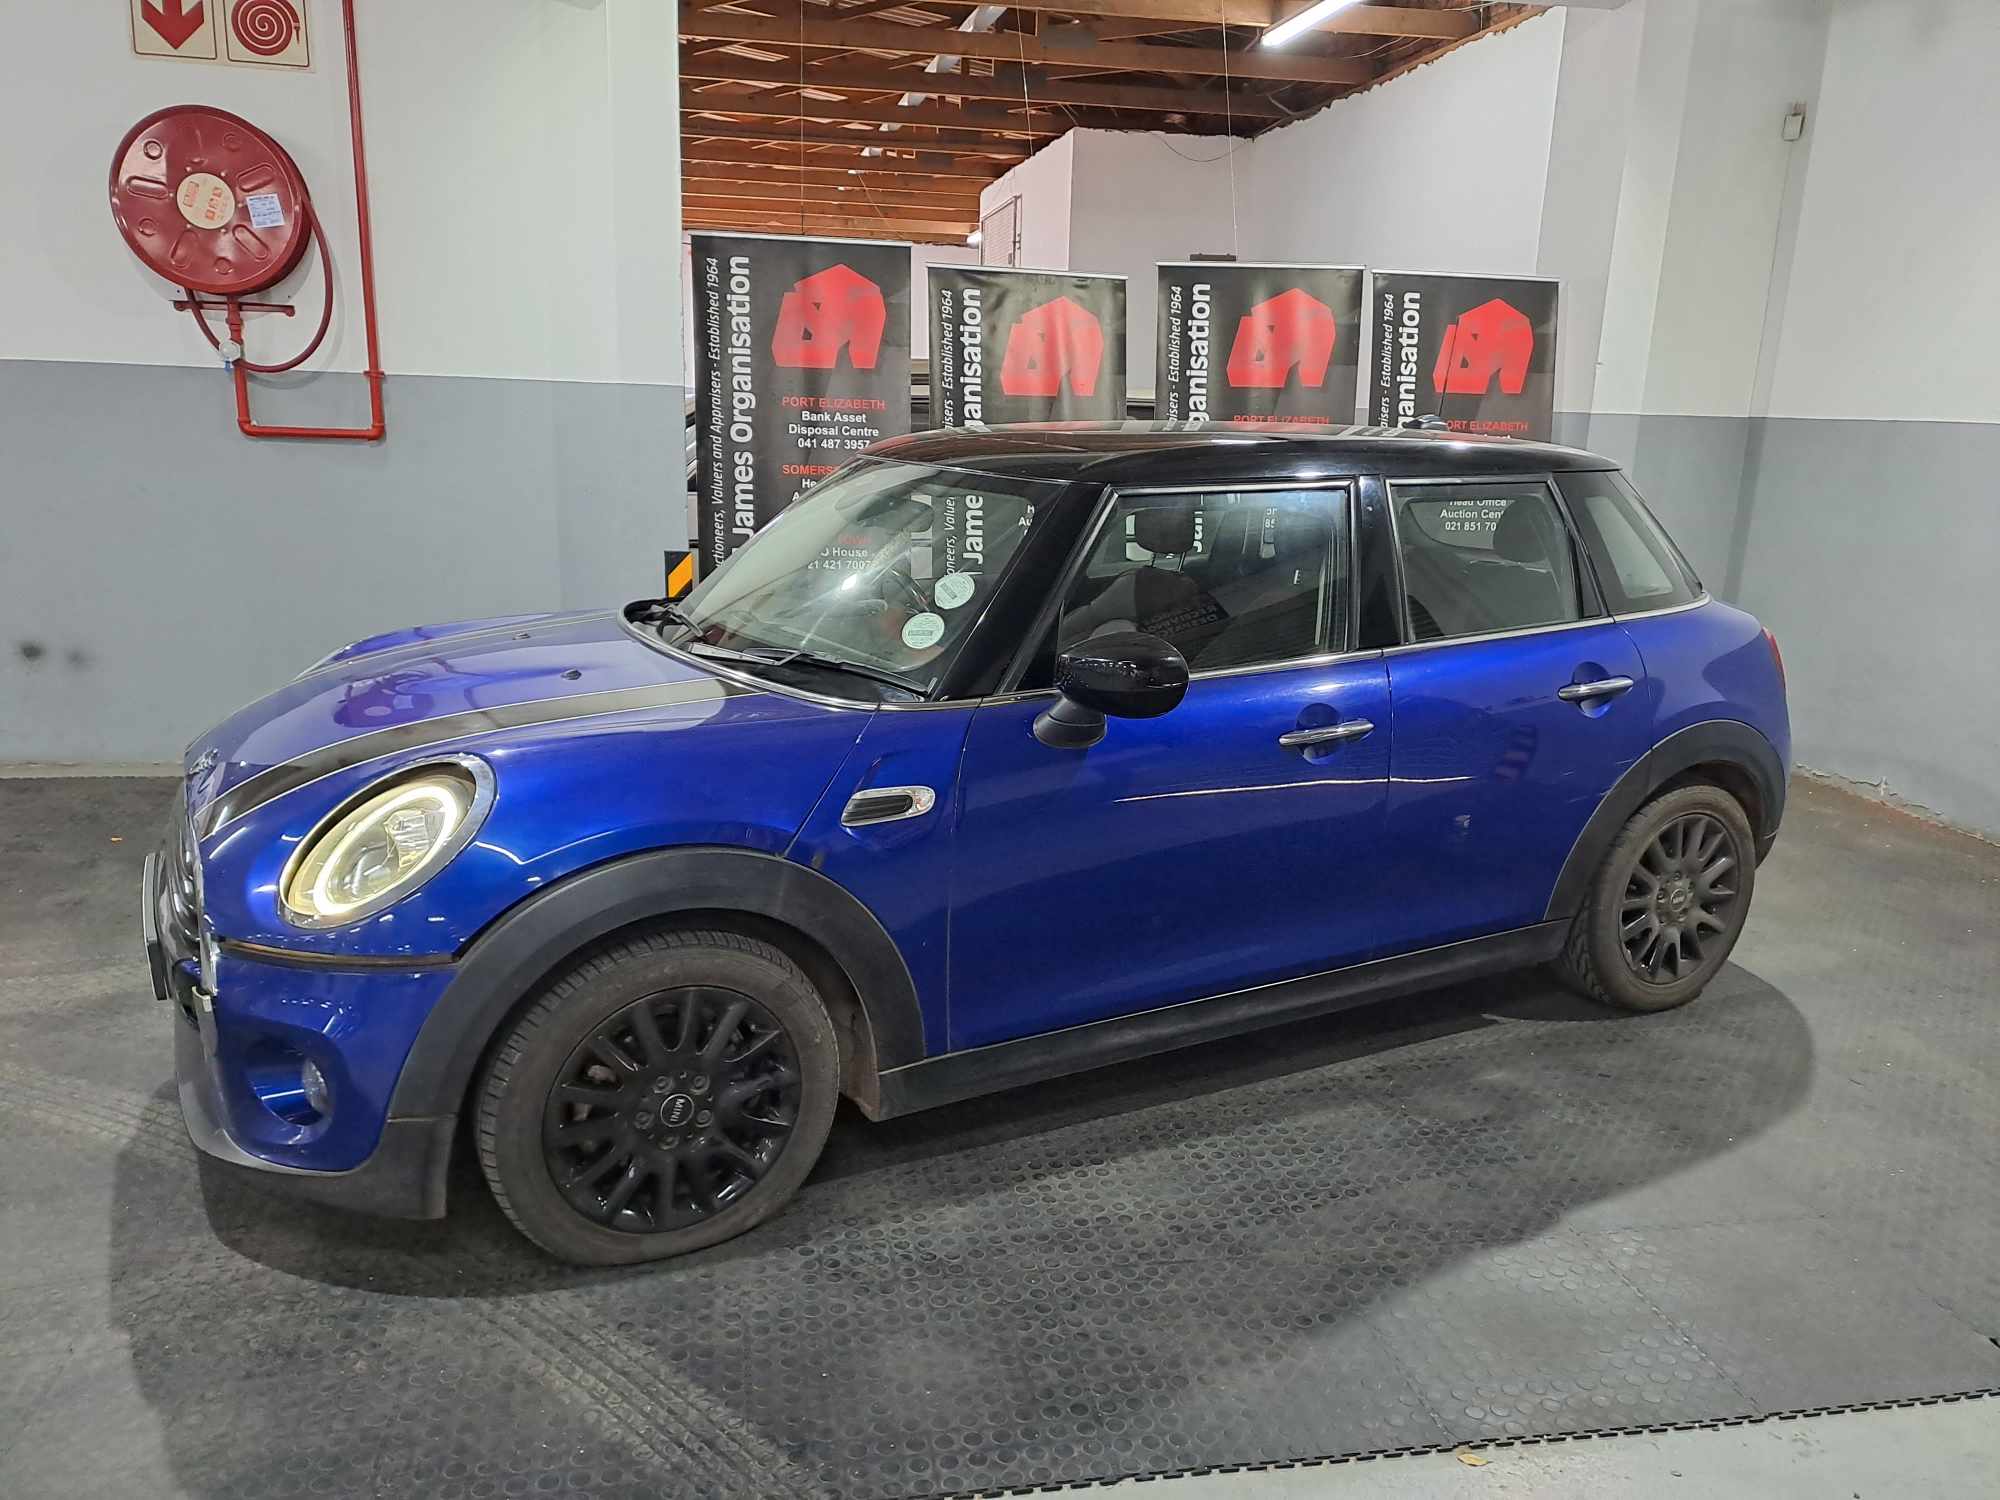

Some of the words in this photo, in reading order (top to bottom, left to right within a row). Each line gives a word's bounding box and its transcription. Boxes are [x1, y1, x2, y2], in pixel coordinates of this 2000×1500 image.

[706, 257, 719, 288] 1964
[941, 290, 953, 318] 1964
[1170, 286, 1182, 313] 1964
[1383, 293, 1394, 321] 1964
[706, 291, 720, 360] Established
[727, 256, 757, 443] Organisation
[941, 322, 953, 389] Established
[1168, 317, 1181, 382] Established
[1381, 325, 1393, 387] Established
[709, 370, 724, 433] Appraisers
[782, 397, 814, 408] PORT
[819, 398, 885, 409] ELIZABETH
[788, 424, 838, 436] Disposal
[842, 426, 879, 437] Centre
[801, 411, 831, 422] Bank
[834, 412, 866, 423] Asset
[709, 435, 722, 458] and
[798, 438, 817, 448] 041
[821, 439, 840, 449] 487
[844, 440, 870, 449] 3957
[711, 462, 723, 504] Valuers
[731, 451, 755, 538] James
[1440, 509, 1477, 518] Auction
[1445, 522, 1460, 531] 021
[1464, 522, 1480, 531] 851
[823, 560, 841, 569] 421
[832, 547, 868, 557] House
[670, 1098, 685, 1122] MINI
